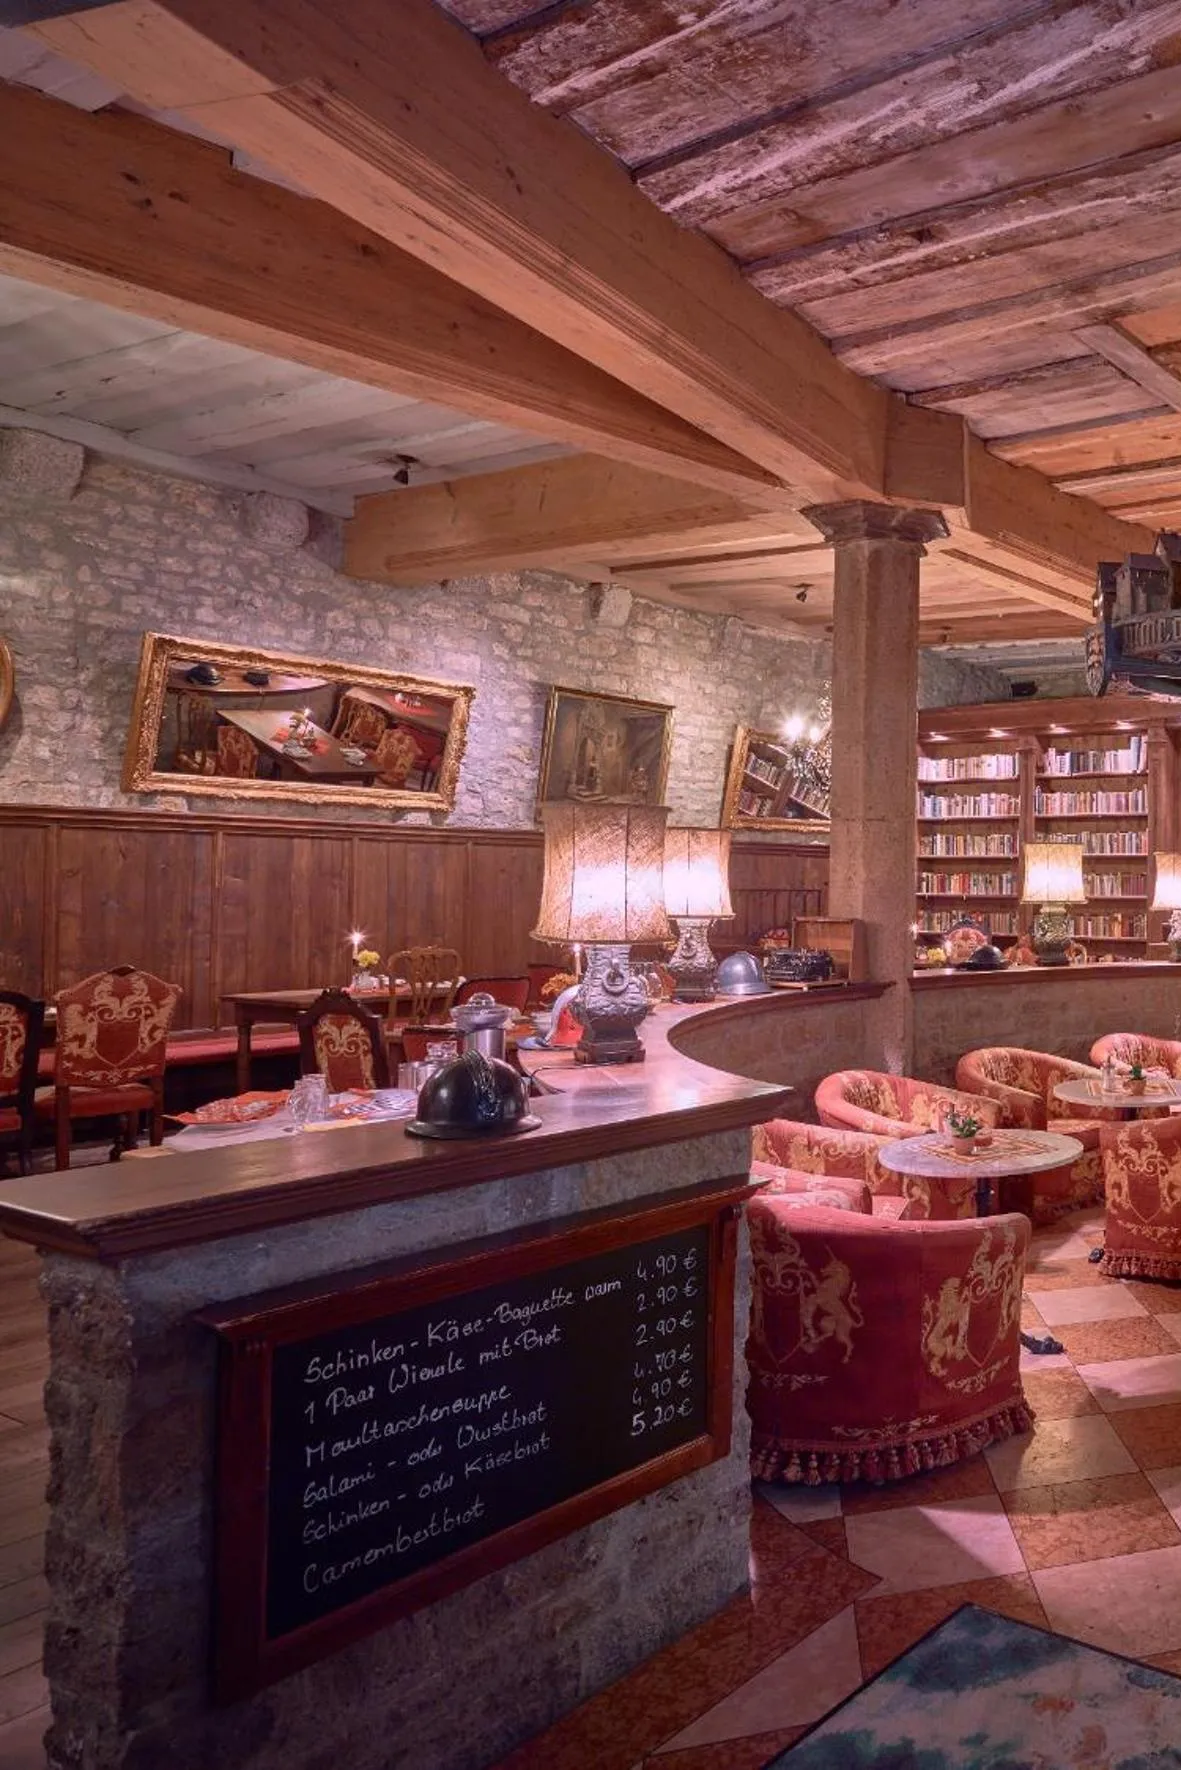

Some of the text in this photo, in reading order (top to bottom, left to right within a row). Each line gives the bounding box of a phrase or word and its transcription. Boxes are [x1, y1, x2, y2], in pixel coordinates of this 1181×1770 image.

[304, 1401, 316, 1425] 1
[326, 1386, 375, 1415] Paar
[479, 1337, 513, 1365] mit
[514, 1324, 562, 1350] Brot
